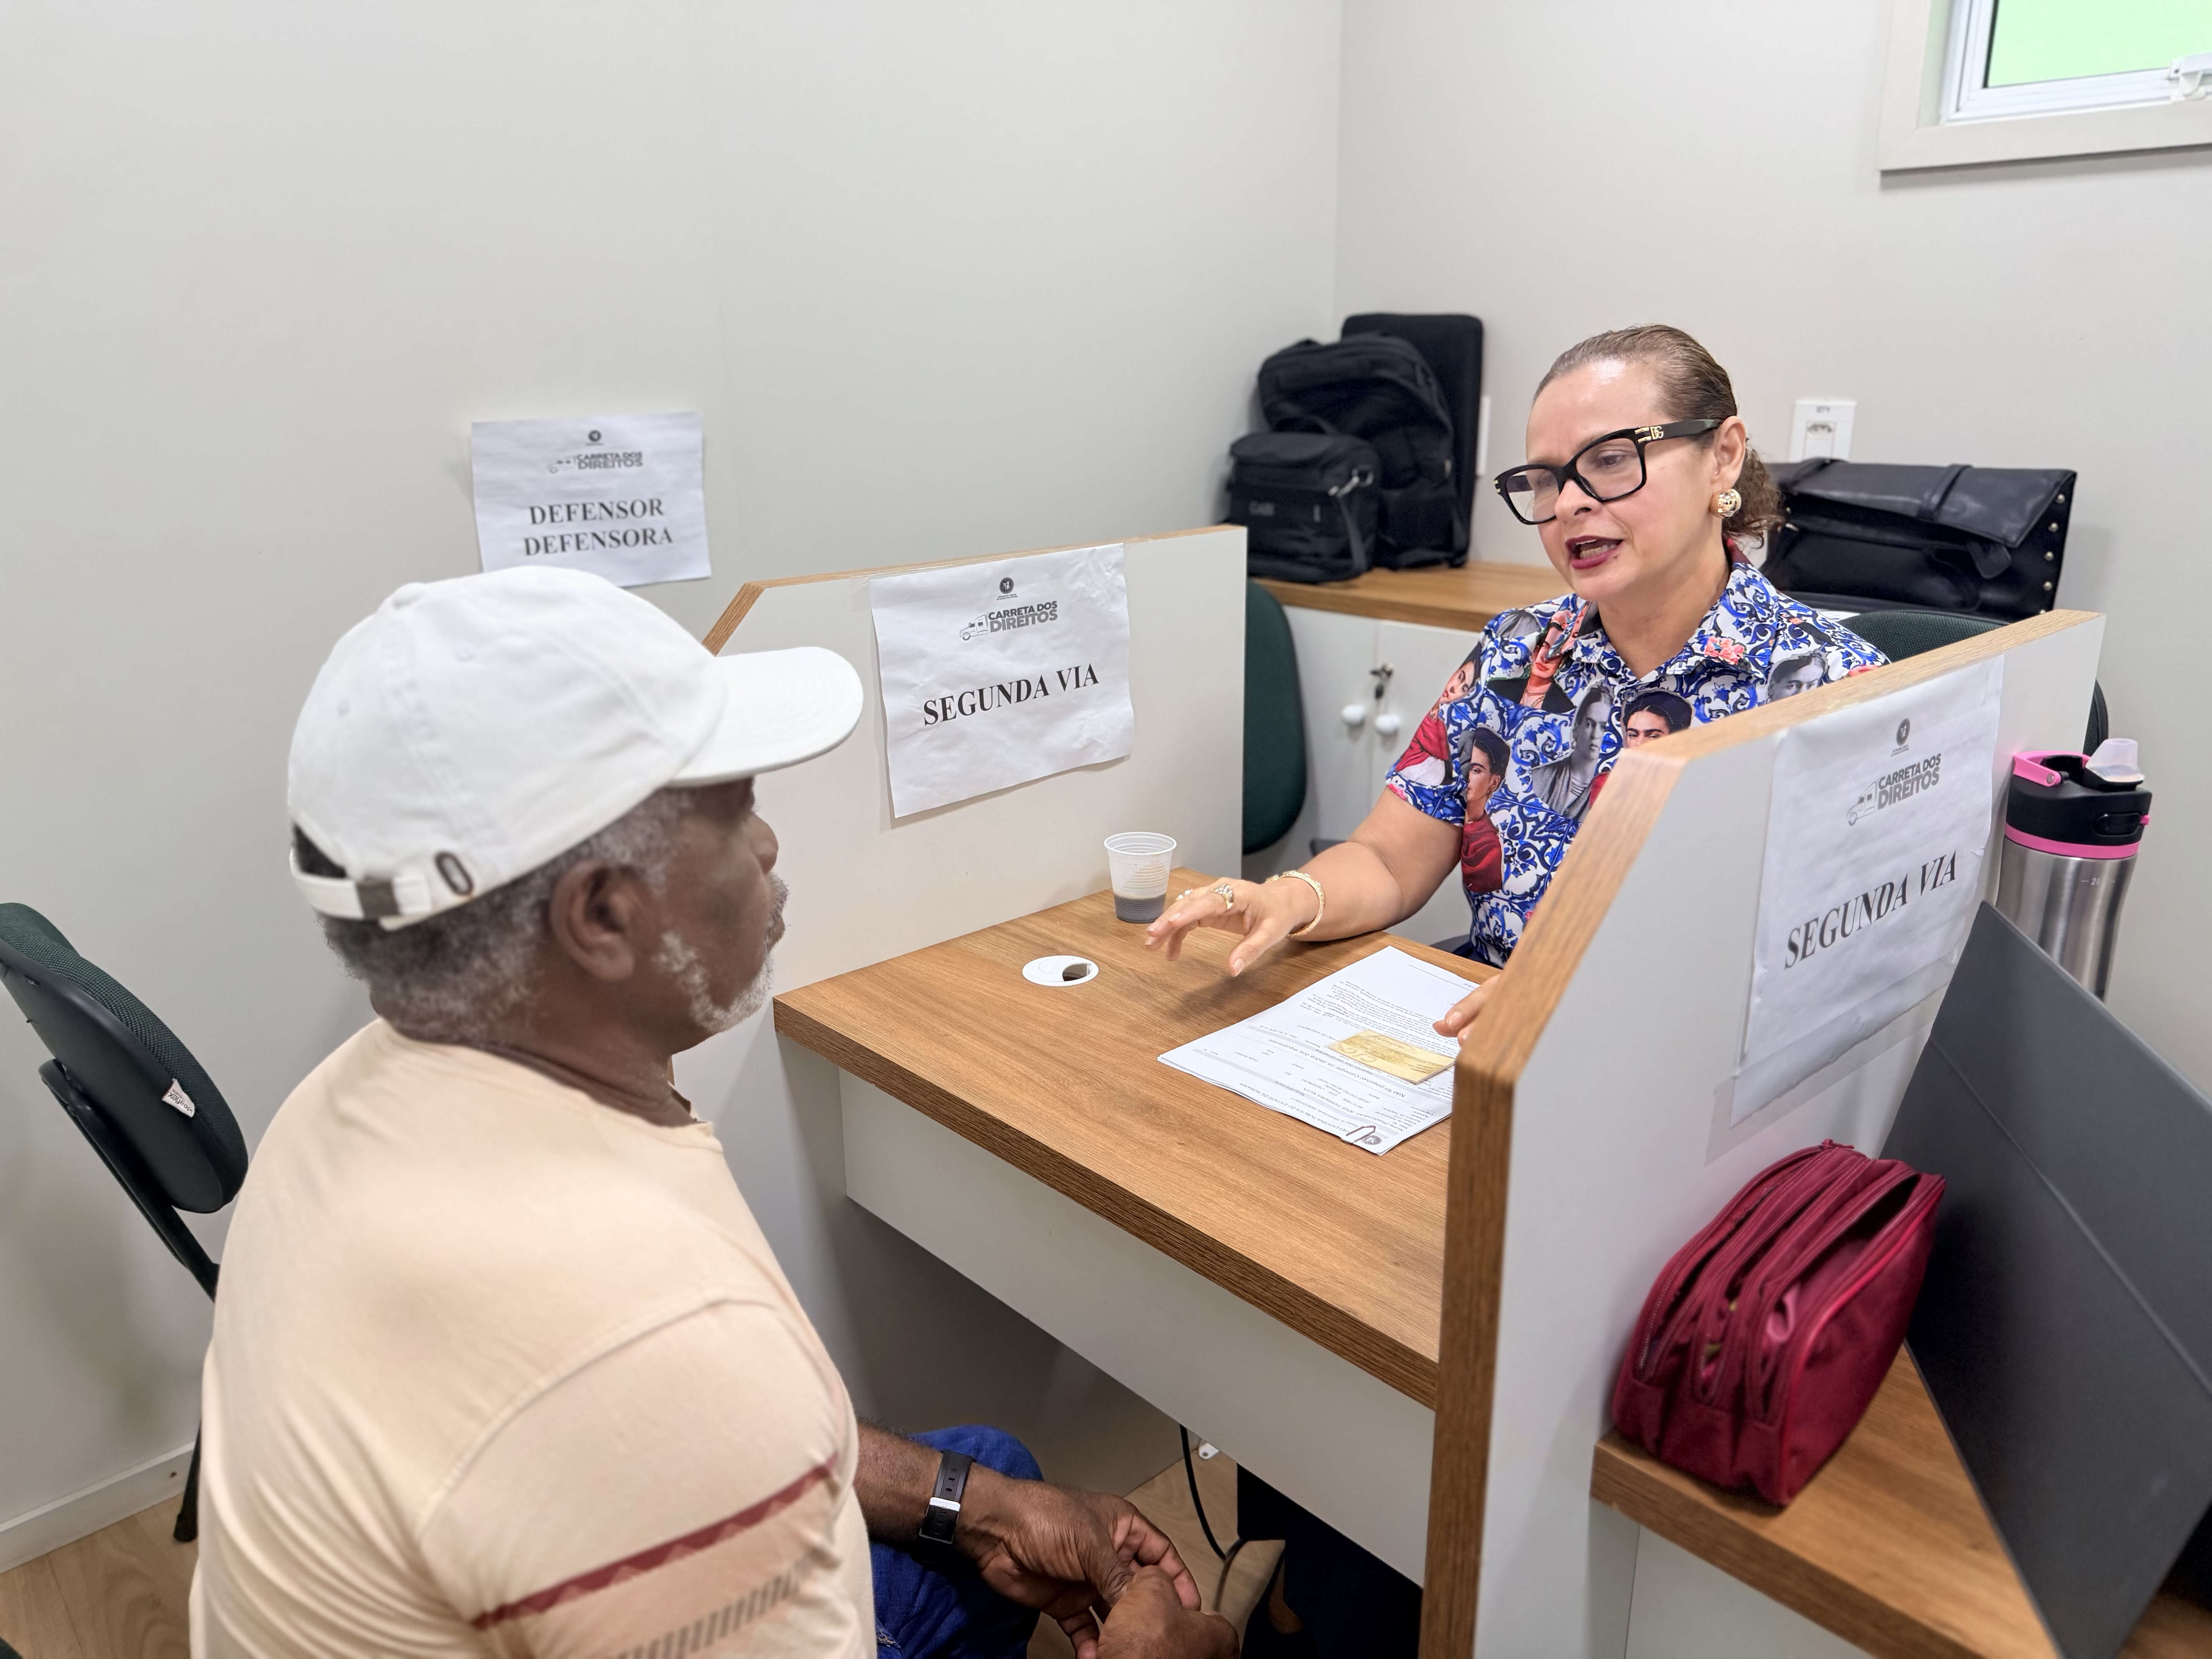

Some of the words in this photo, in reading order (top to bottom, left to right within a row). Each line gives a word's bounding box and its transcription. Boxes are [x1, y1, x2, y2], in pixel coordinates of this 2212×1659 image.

[577, 453, 620, 461] CARRETA
[623, 452, 642, 460] DOS
[578, 459, 643, 470] DIREITOS
[529, 498, 665, 525] DEFENSOR
[524, 526, 673, 556] DEFENSORA
[988, 605, 1035, 620] CARRETA
[1037, 601, 1058, 612] DOS
[990, 609, 1058, 633] DIREITOS
[923, 675, 1050, 726] SEGUNDA
[1056, 663, 1099, 692] VIA
[1878, 762, 1921, 790] CARRETA
[1923, 753, 1941, 773] DOS
[1877, 766, 1940, 810] DIREITOS
[1784, 872, 1908, 970] SEGUNDA
[1920, 849, 1957, 897] VIA
[1268, 1039, 1299, 1051] requerentes
[1310, 1055, 1327, 1063] dados
[1334, 1066, 1360, 1078] Carregar
[168, 1092, 193, 1113] ideaflex
